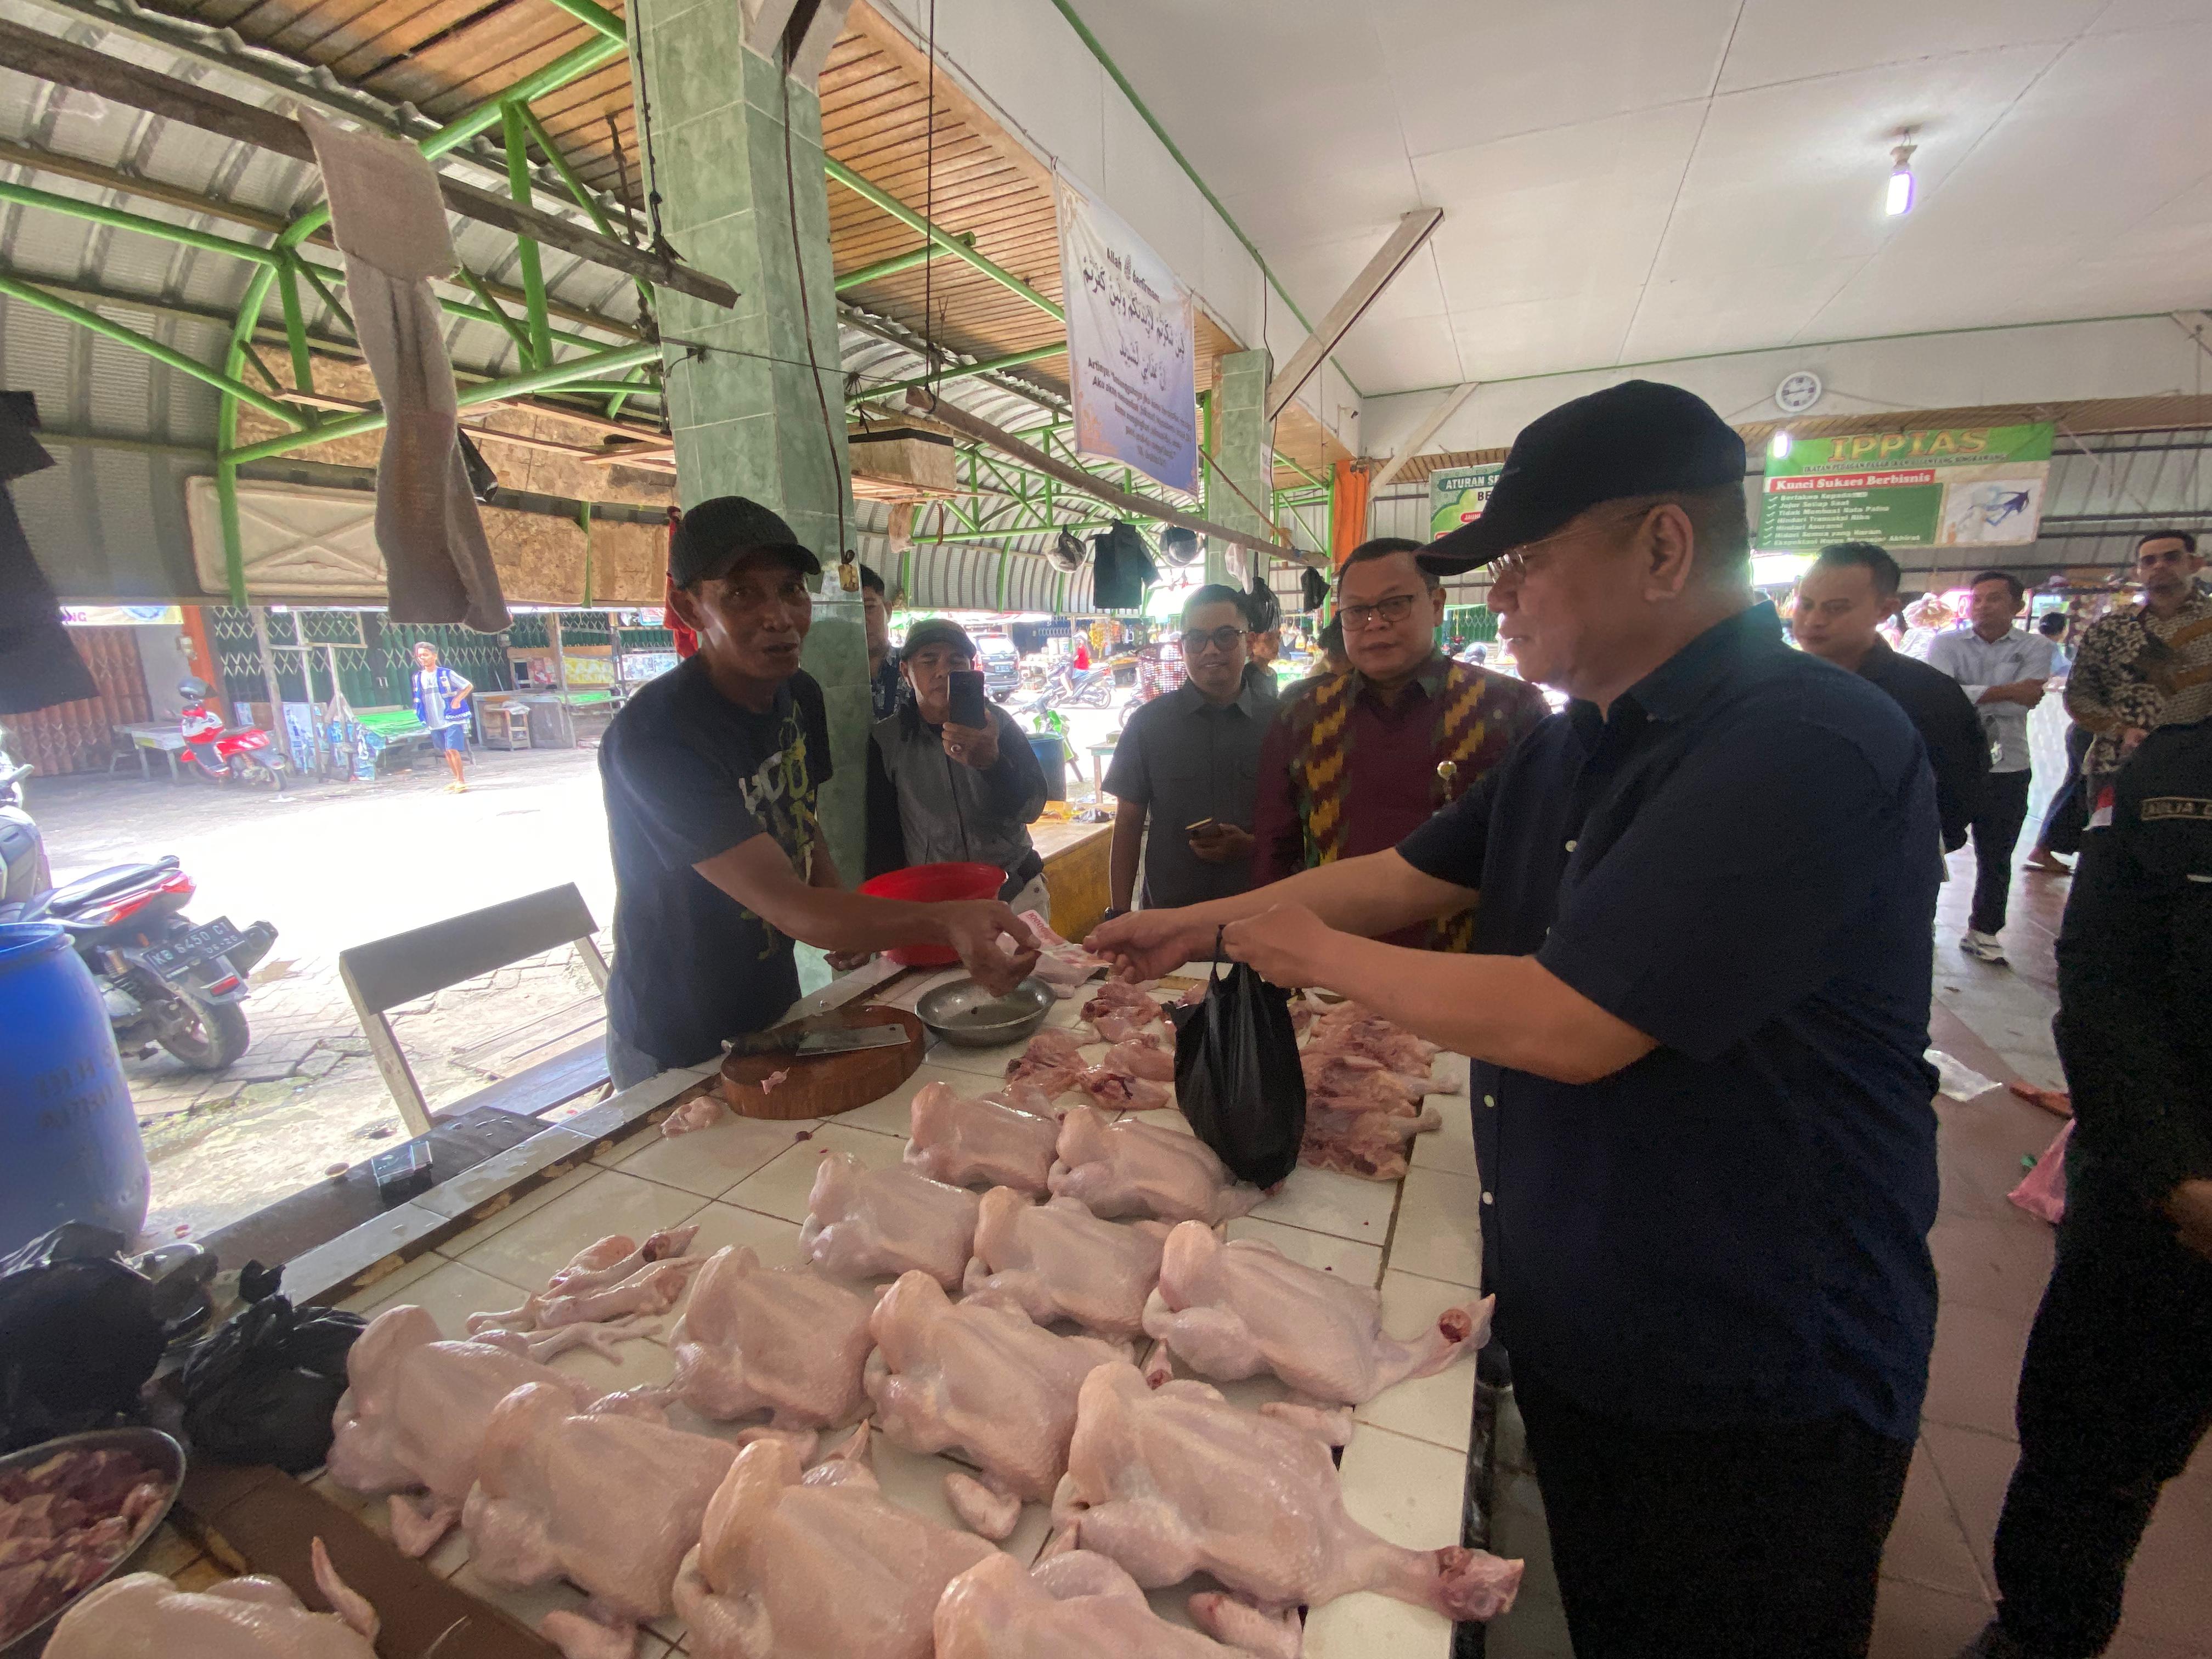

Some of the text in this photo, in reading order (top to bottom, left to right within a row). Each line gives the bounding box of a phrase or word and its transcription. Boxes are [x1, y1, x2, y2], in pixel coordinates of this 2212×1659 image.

[1107, 247, 1122, 271] Allah
[1092, 376, 1104, 389] Aku
[1827, 428, 1989, 462] IPPIAS
[1446, 476, 1485, 490] ATURAN
[1776, 474, 1932, 490] Kunci Sukses Berbisnis
